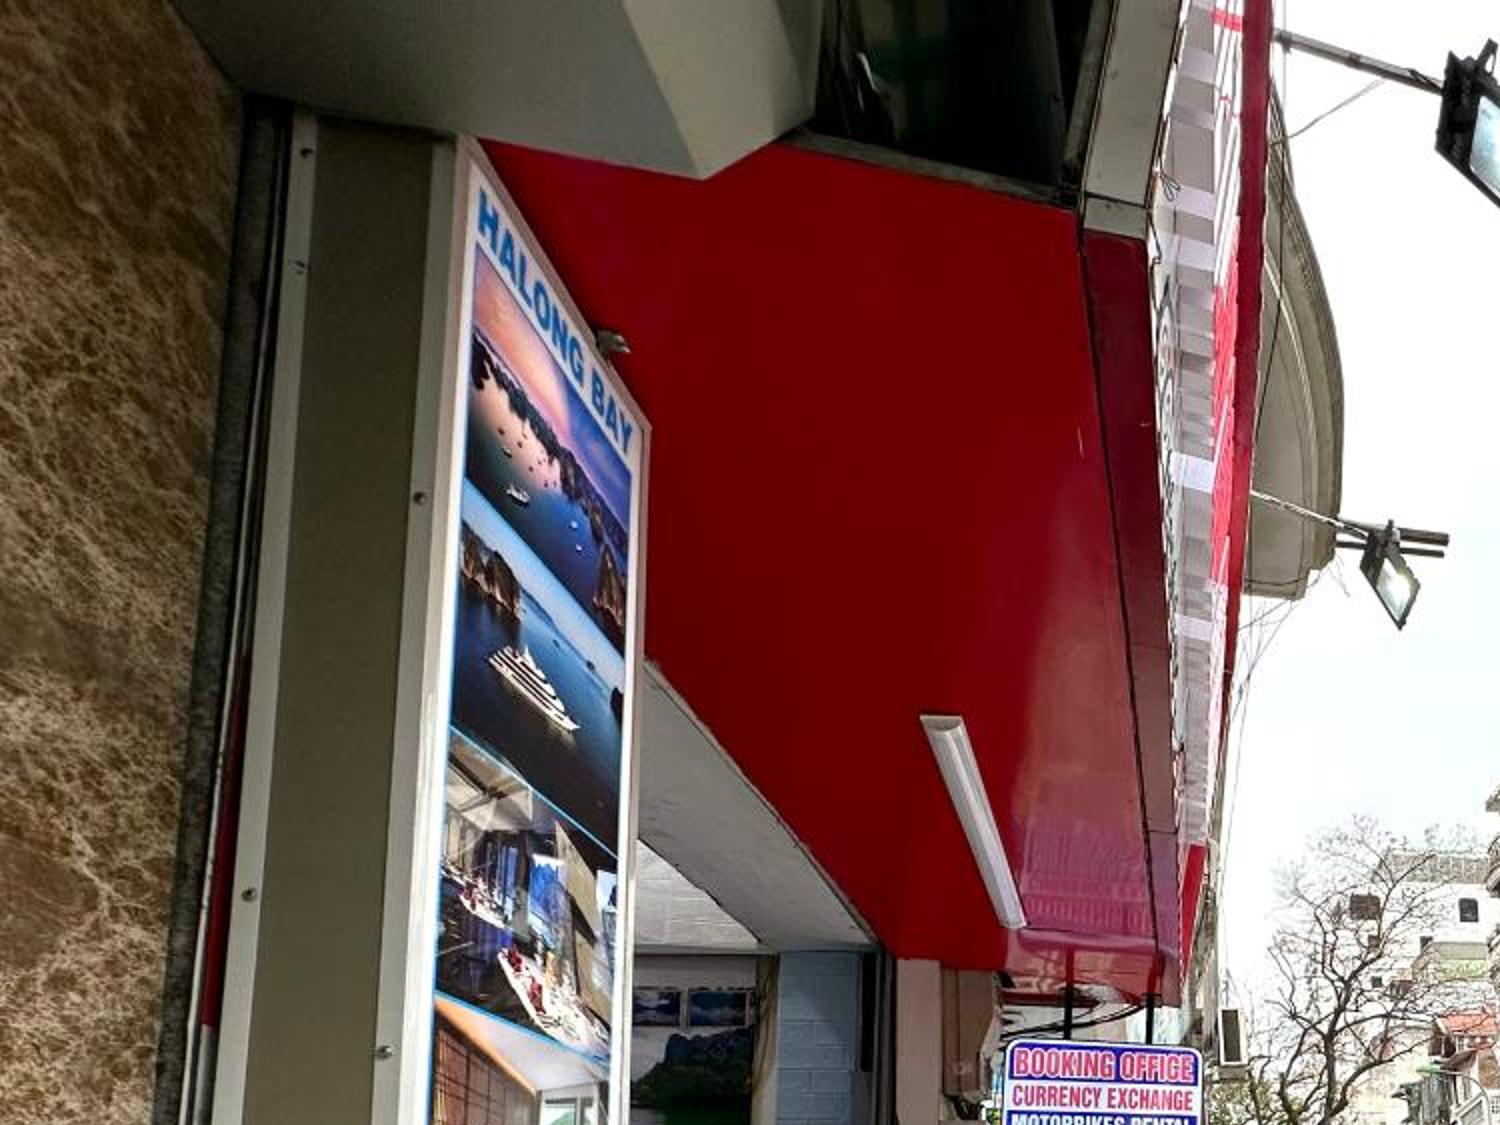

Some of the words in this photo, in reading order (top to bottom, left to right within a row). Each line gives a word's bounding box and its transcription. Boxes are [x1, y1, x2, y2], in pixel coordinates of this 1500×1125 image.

[478, 190, 584, 387] HALONG
[591, 368, 634, 452] BAY
[1014, 1048, 1115, 1079] BOOKING
[1120, 1052, 1195, 1083] OFFICE
[1012, 1083, 1102, 1109] CURRENCY
[1107, 1087, 1193, 1112] EXCHANGE
